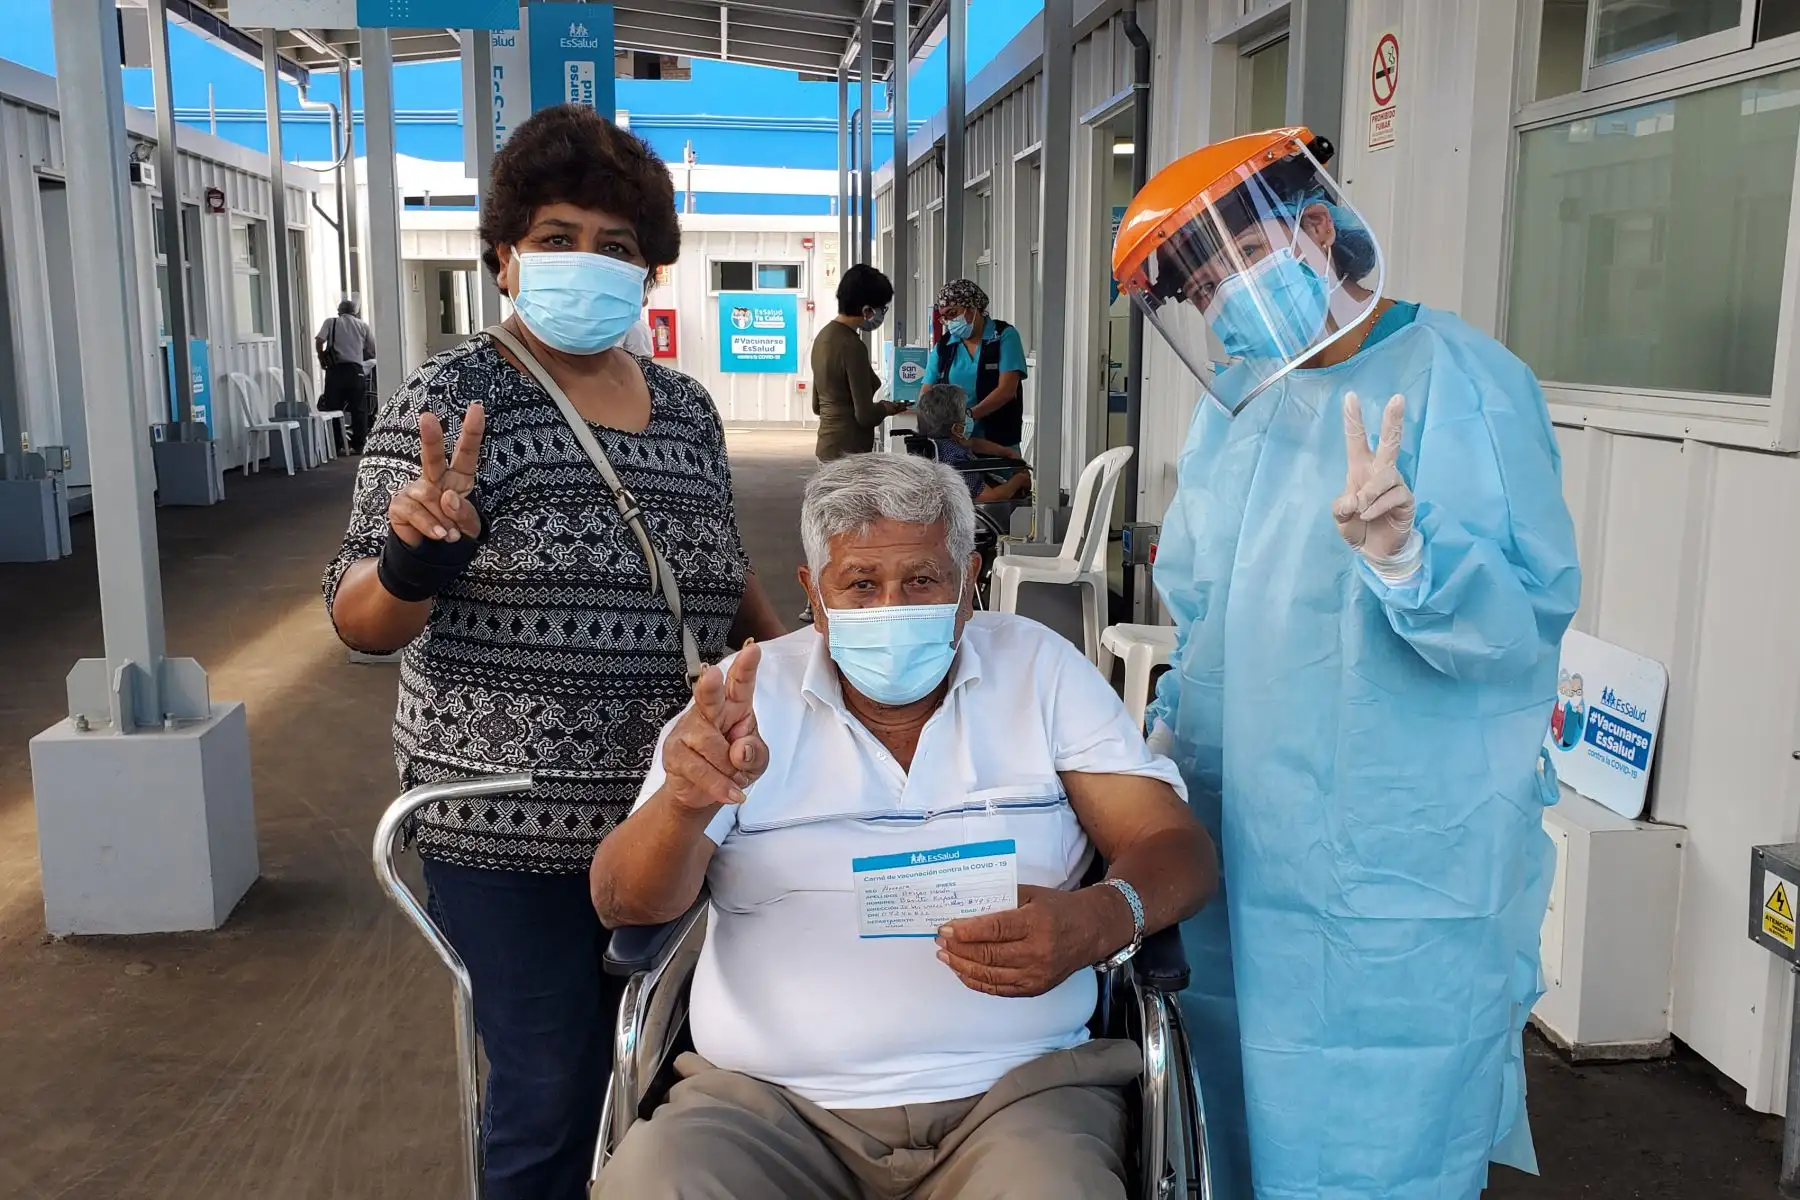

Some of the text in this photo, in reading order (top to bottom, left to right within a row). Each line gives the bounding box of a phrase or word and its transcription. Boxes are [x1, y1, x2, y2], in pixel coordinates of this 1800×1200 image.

[560, 38, 598, 48] EsSalud
[1372, 109, 1396, 124] PROHIBIDO
[1376, 120, 1391, 131] FUMAR
[734, 337, 784, 345] #Vacunarse
[1616, 698, 1647, 723] EsSalud
[1589, 711, 1649, 749] #Vacunarse
[1596, 730, 1636, 762] EsSalud
[1588, 748, 1638, 779] contra la COVID-19
[928, 850, 960, 862] EsSalud
[938, 866, 962, 874] contra
